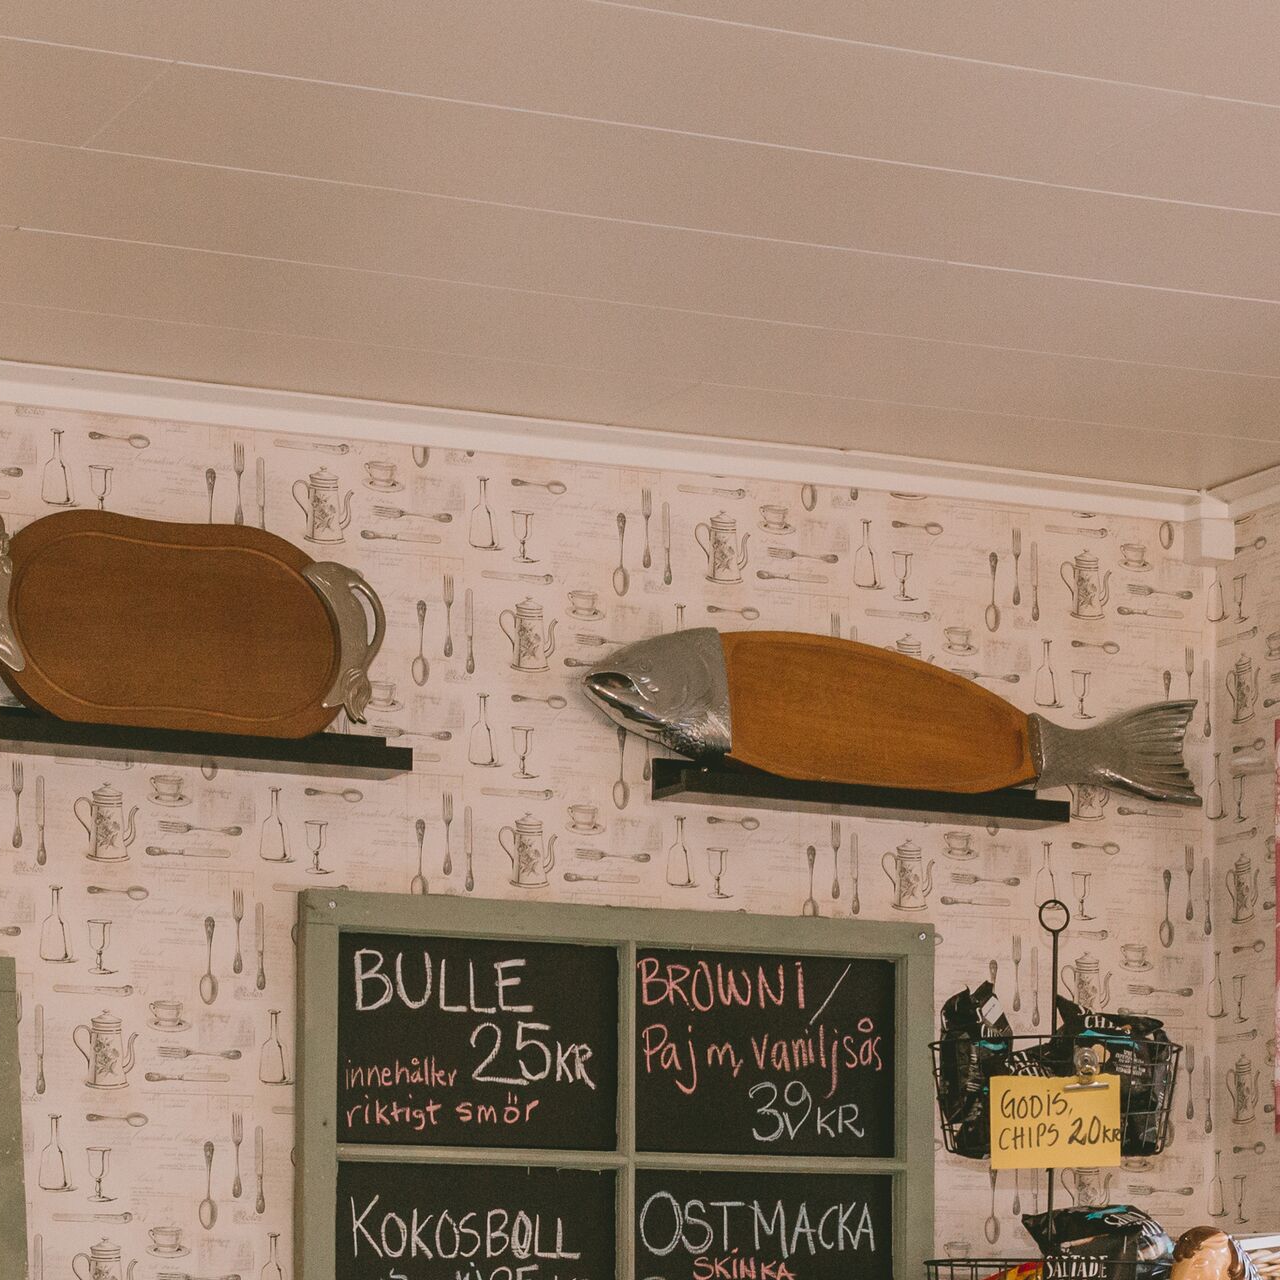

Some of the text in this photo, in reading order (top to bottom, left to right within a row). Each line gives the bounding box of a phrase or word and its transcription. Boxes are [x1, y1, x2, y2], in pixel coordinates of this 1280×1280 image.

[353, 948, 535, 1014] BULLE
[642, 1024, 697, 1095] Paj
[751, 1017, 883, 1100] vaniljsås
[346, 1091, 540, 1131] riktigt smör
[999, 1122, 1059, 1150] CHIPS
[350, 1194, 581, 1260] KOKOSBOLL
[1046, 1255, 1108, 1279] SALTADE
